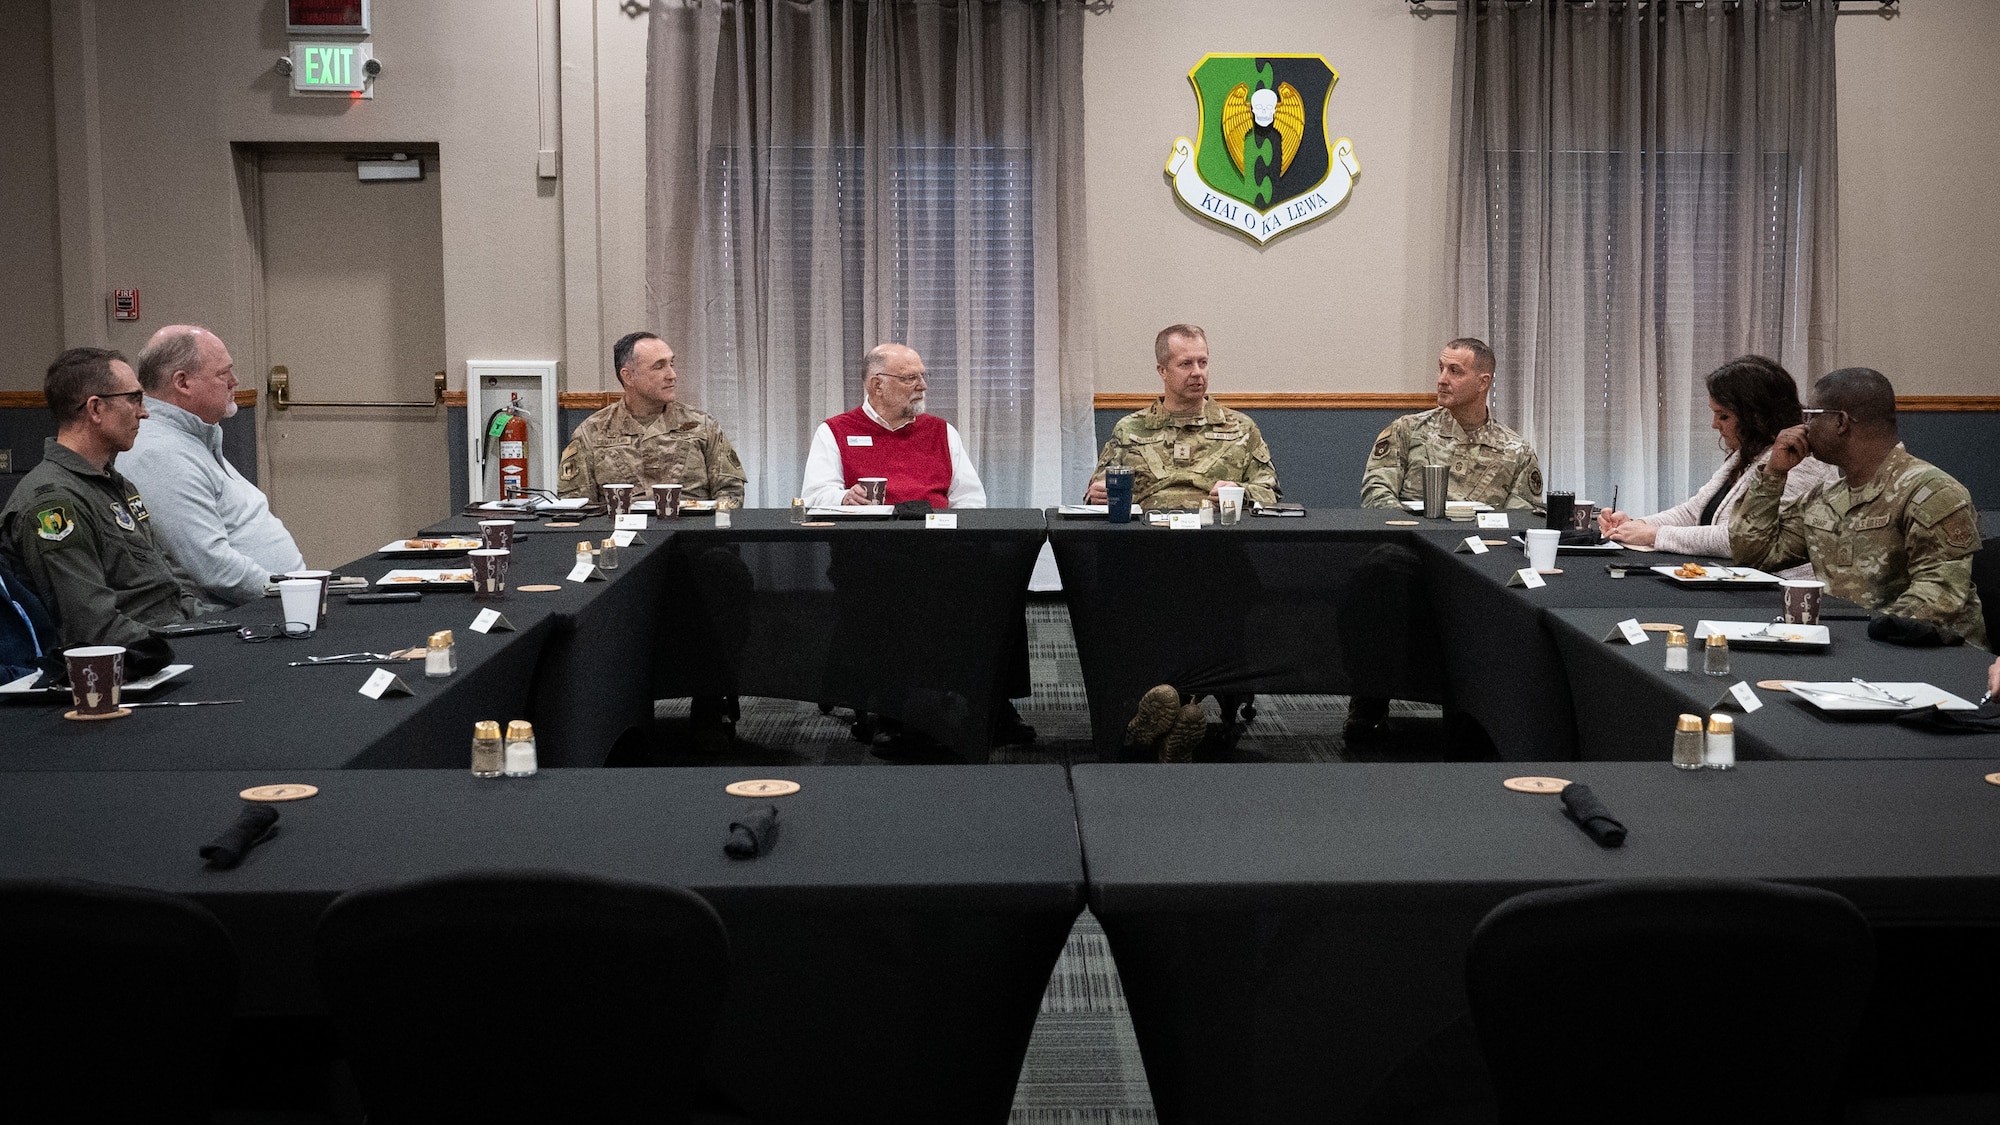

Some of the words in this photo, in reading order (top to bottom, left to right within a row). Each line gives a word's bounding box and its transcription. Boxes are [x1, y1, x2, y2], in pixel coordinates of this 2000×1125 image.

[305, 47, 353, 85] EXIT
[1200, 193, 1239, 221] KIAI
[1244, 213, 1256, 229] O
[1261, 214, 1282, 236] KA
[1286, 193, 1328, 221] LEWA
